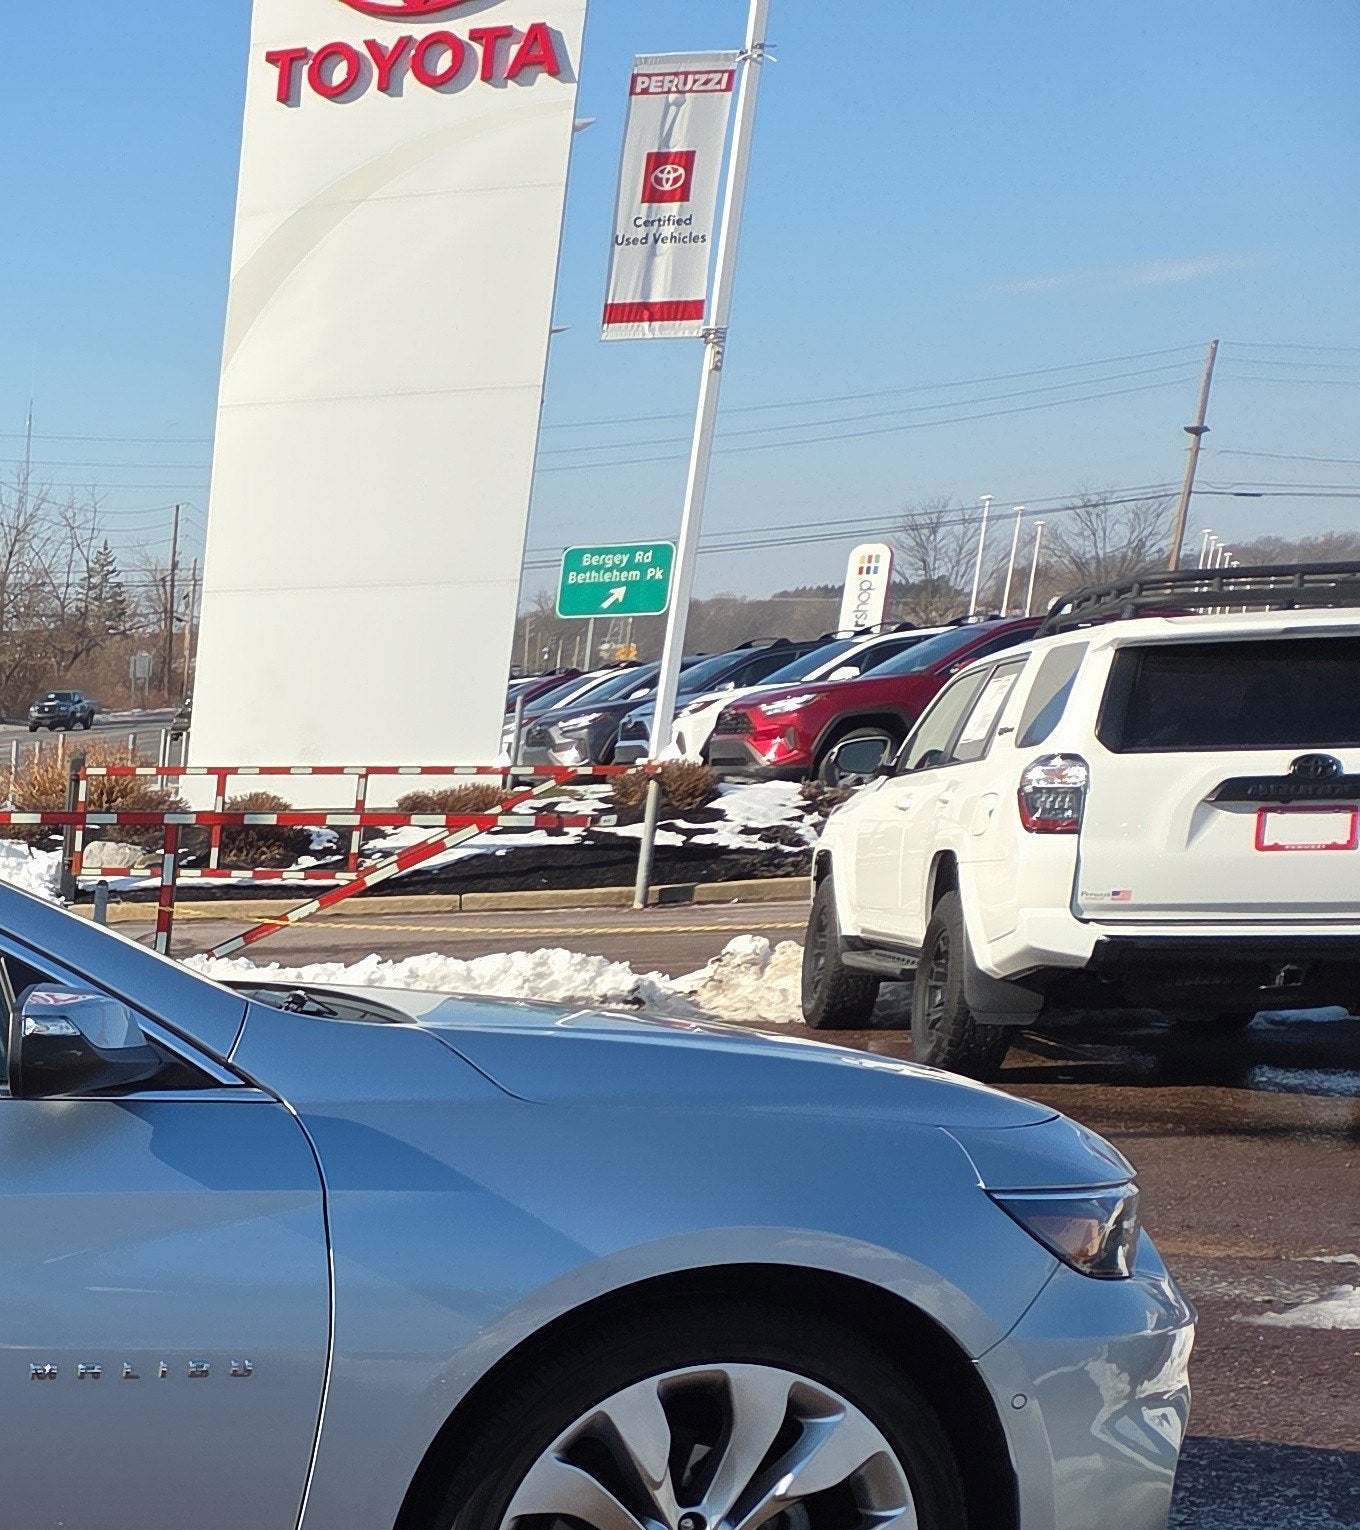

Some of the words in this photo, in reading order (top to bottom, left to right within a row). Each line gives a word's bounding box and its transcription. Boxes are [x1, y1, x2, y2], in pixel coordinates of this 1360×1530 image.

[265, 22, 560, 103] TOYOTA
[635, 72, 730, 94] PERUZZI
[633, 214, 693, 229] Certified
[615, 234, 649, 246] Used
[652, 232, 707, 245] Vehicles
[582, 552, 630, 568] Bergey
[635, 550, 653, 563] Rd
[567, 568, 641, 584] Bethlehem
[646, 566, 664, 581] Pk
[853, 580, 876, 628] rshop
[29, 1359, 255, 1381] MALIBU
